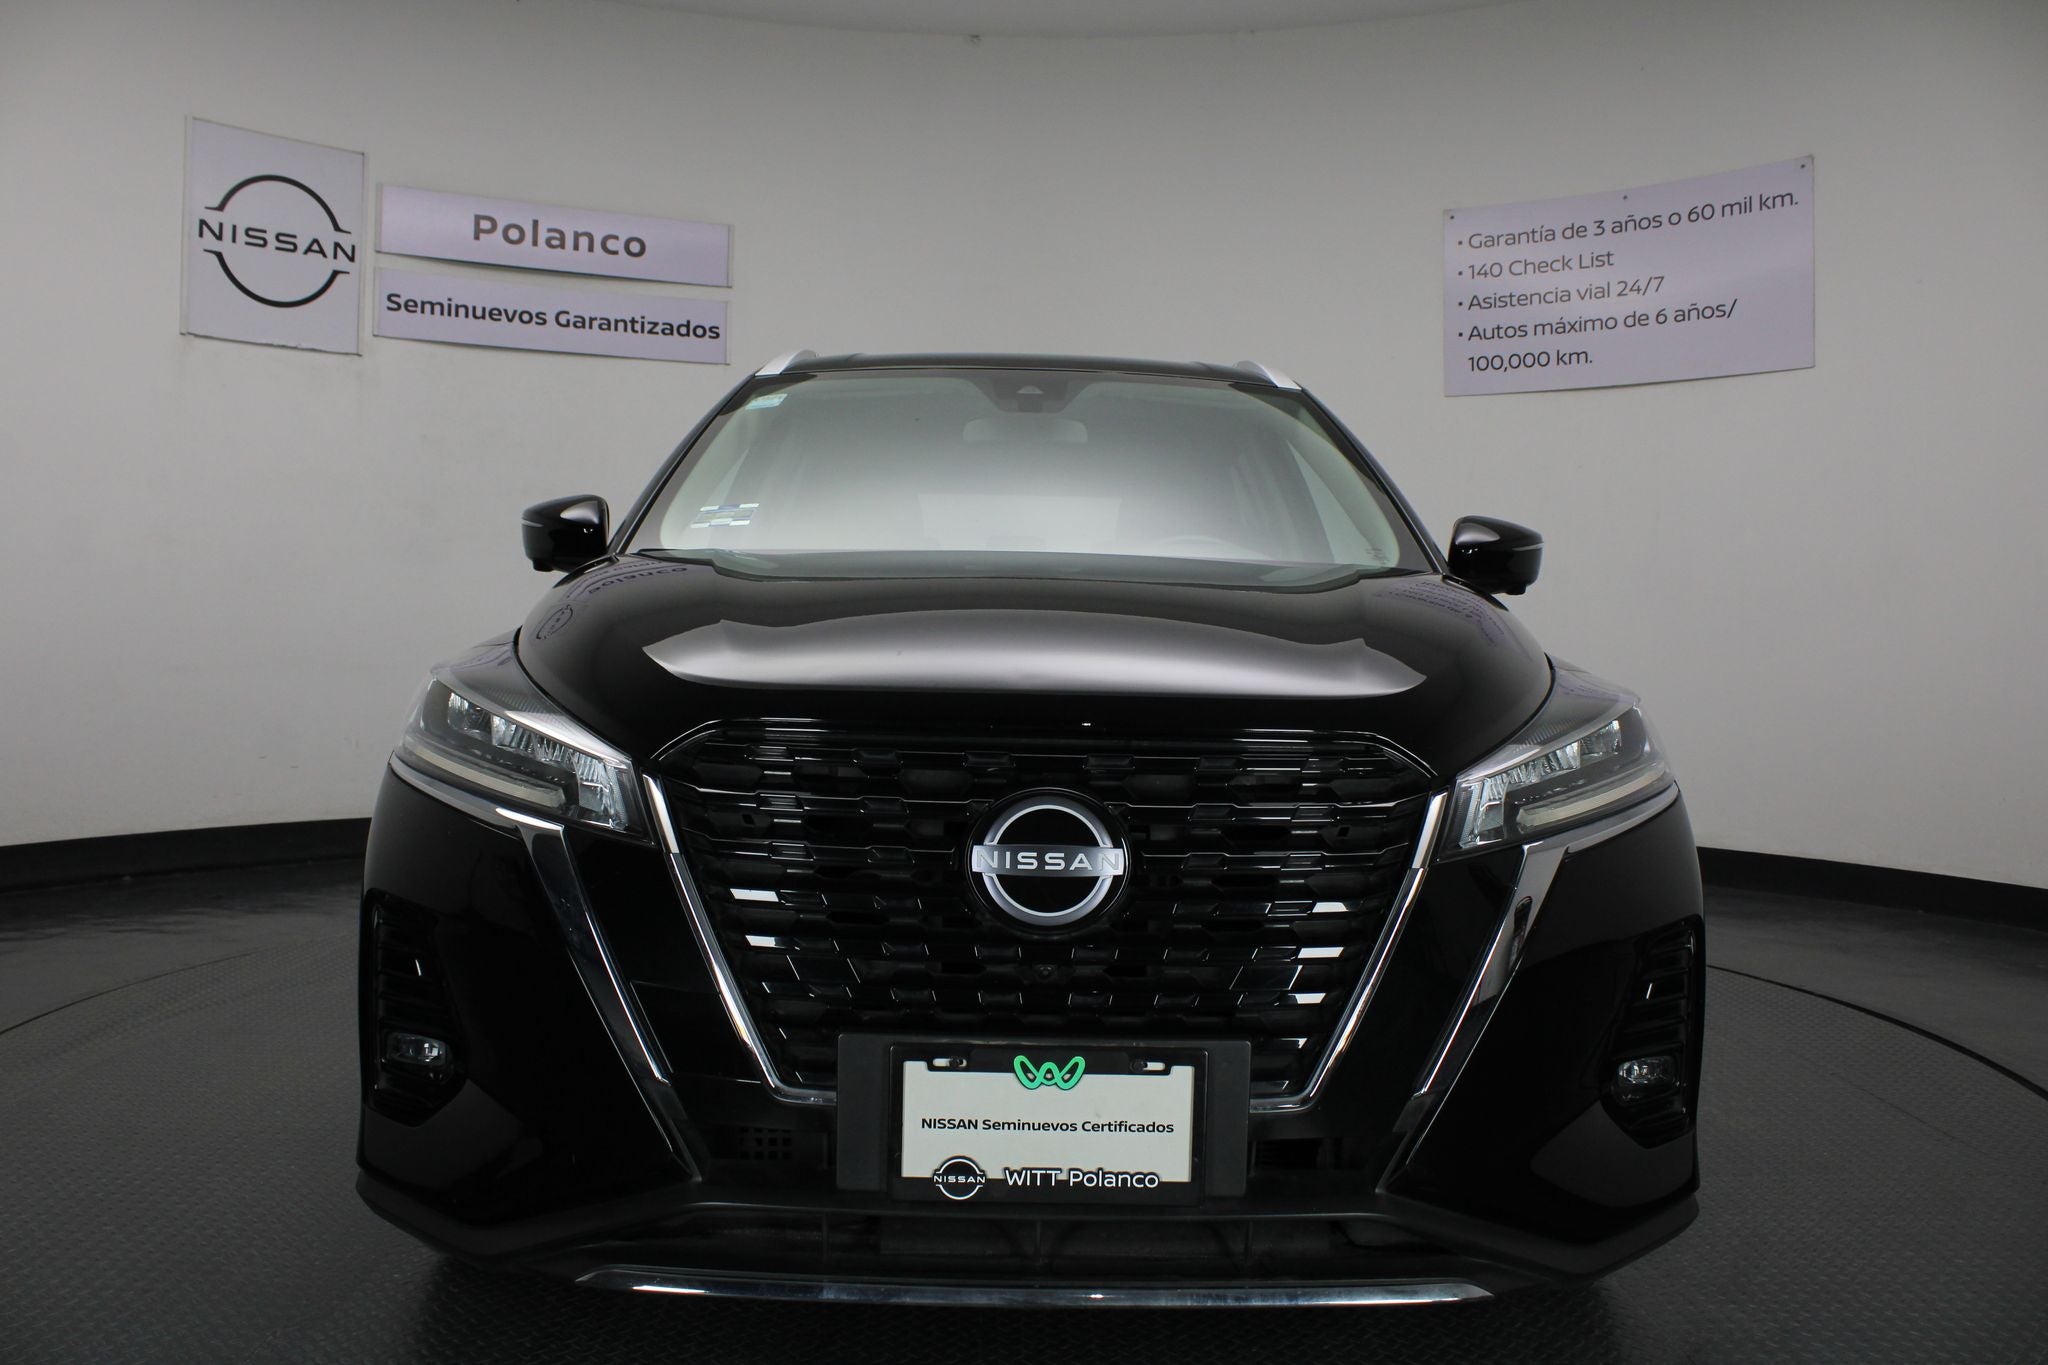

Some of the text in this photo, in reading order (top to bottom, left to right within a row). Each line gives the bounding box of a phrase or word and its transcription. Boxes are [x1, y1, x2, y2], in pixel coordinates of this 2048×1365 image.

[472, 213, 647, 258] Polanco
[1468, 189, 1800, 250] Garantía de 3 años o 60 mil km.
[198, 218, 356, 263] NISSAN
[1468, 249, 1615, 280] 140 Check List
[1467, 275, 1665, 311] Asistencia vial 24/7
[386, 292, 721, 341] Seminuevos Garantizados
[1467, 299, 1738, 342] Autos máximo de 6 años/
[1468, 348, 1593, 374] 100,000 km.
[976, 850, 1120, 871] NISSAN
[921, 1118, 1175, 1134] NISSAN Seminuevos Certificados
[933, 1174, 986, 1184] NISSAN
[1004, 1169, 1160, 1189] WITT Polanco
